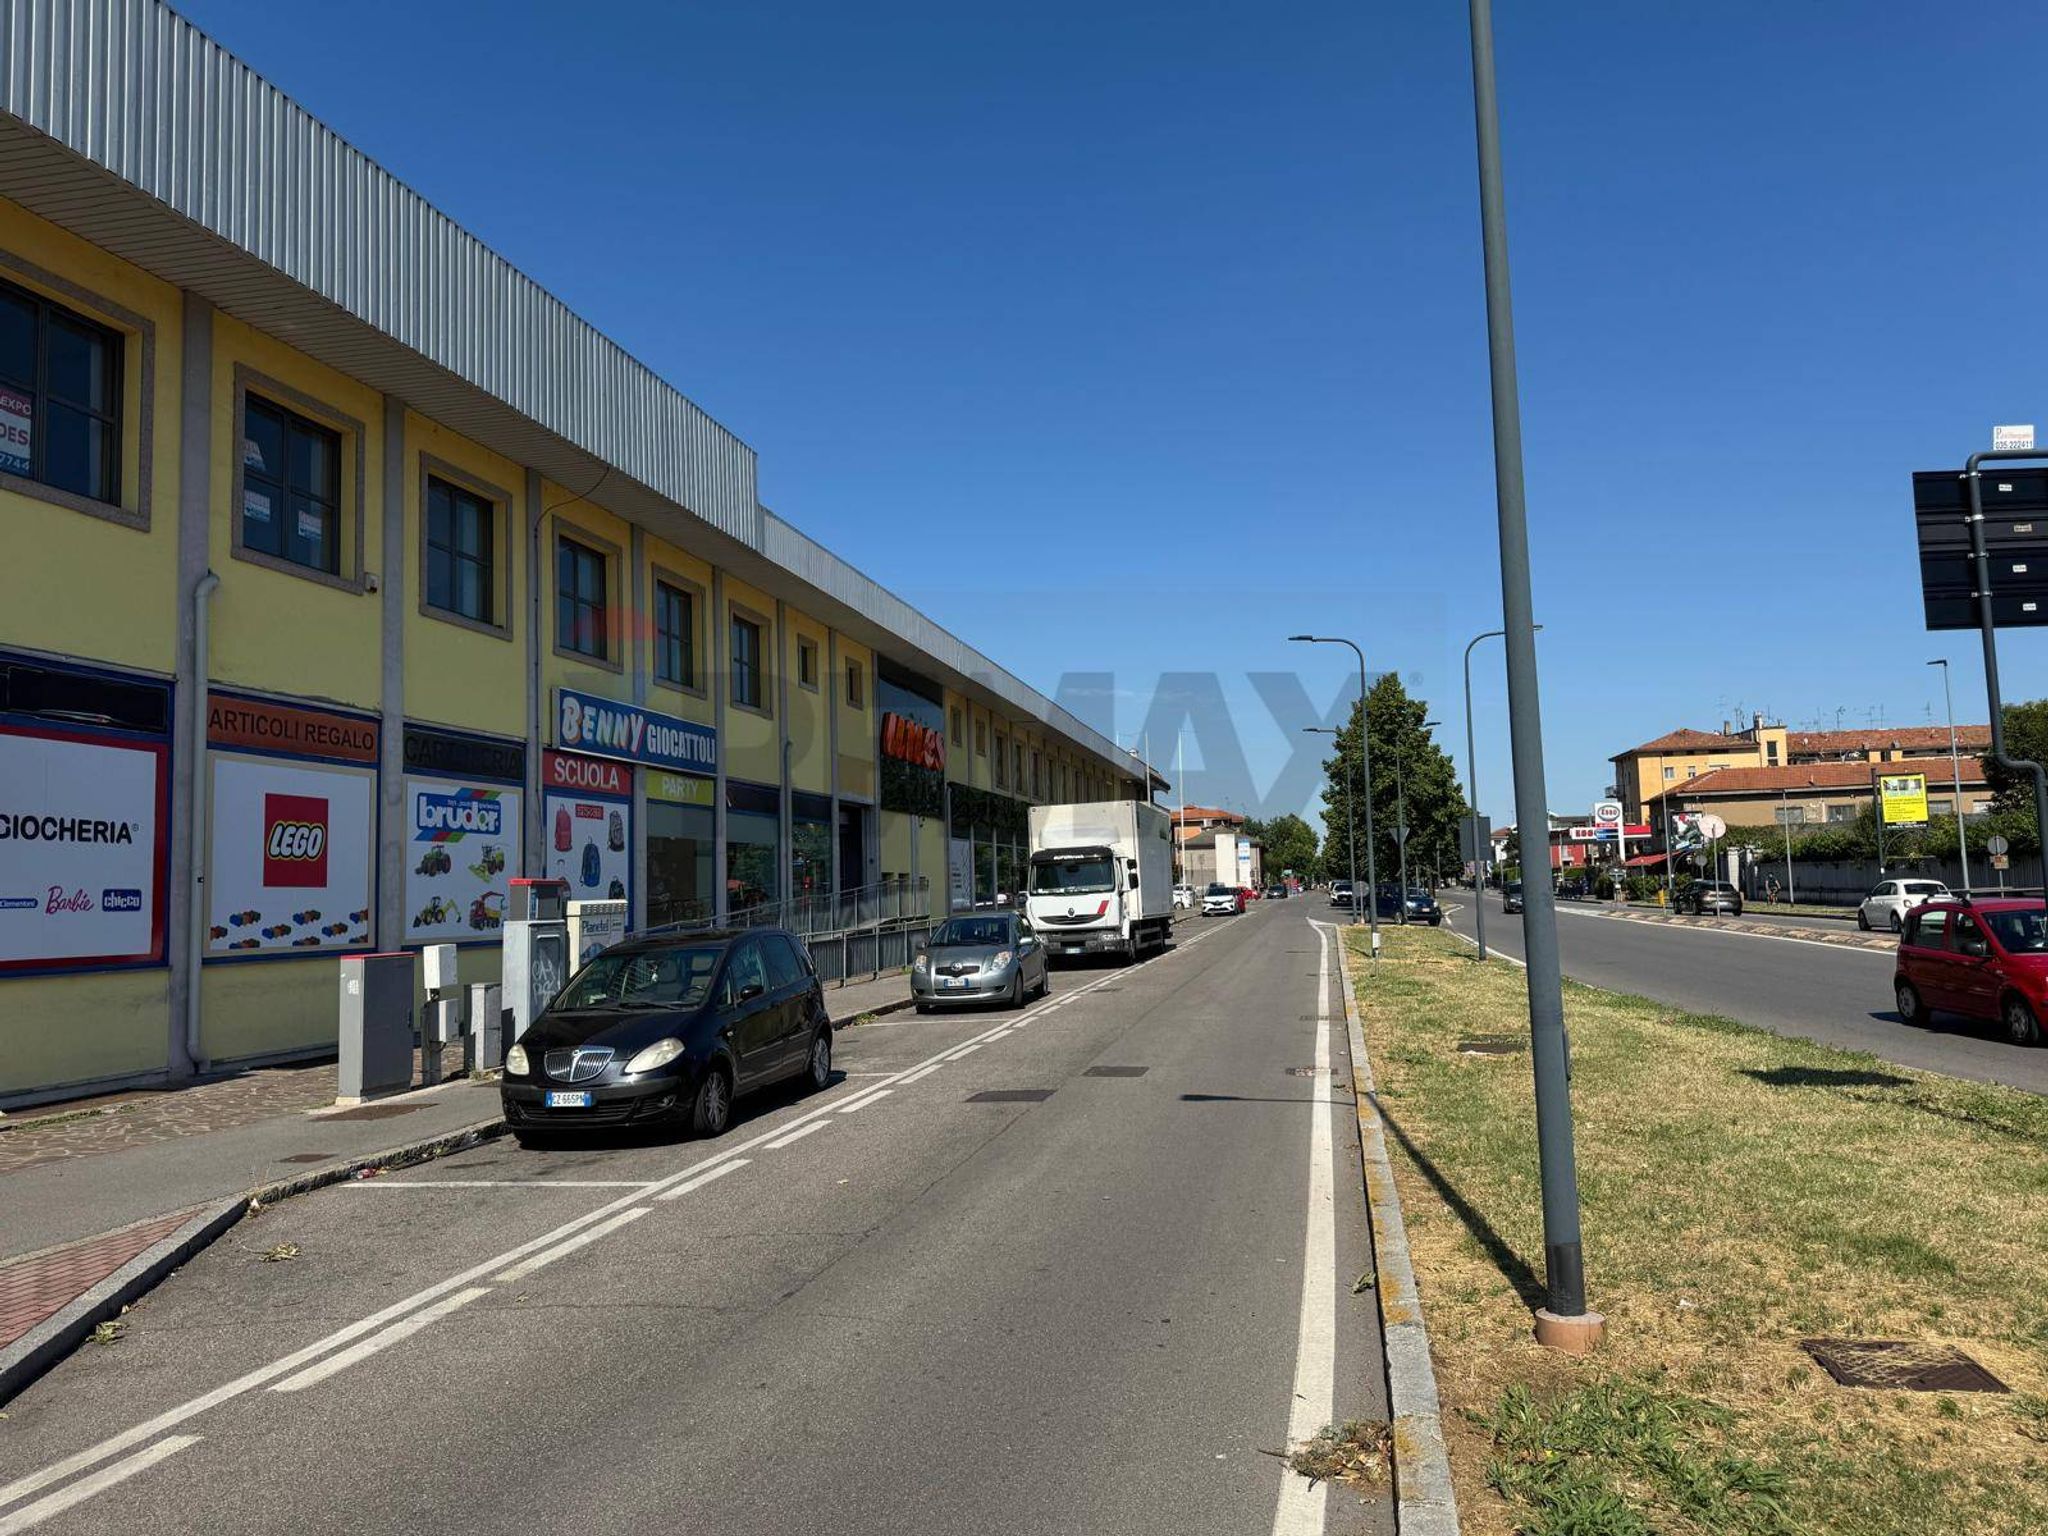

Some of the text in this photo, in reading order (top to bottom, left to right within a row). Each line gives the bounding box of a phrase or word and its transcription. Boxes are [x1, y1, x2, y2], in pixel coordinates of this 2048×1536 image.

[208, 708, 374, 750] ARTICOLI REGALO
[562, 697, 716, 764] BENNY GIOCATTOLI
[554, 757, 620, 790] SCUOLA
[661, 775, 699, 798] PARTY
[419, 796, 498, 832] bruder
[269, 822, 325, 860] LEGO
[45, 886, 94, 914] Barbie
[104, 892, 140, 908] chicco
